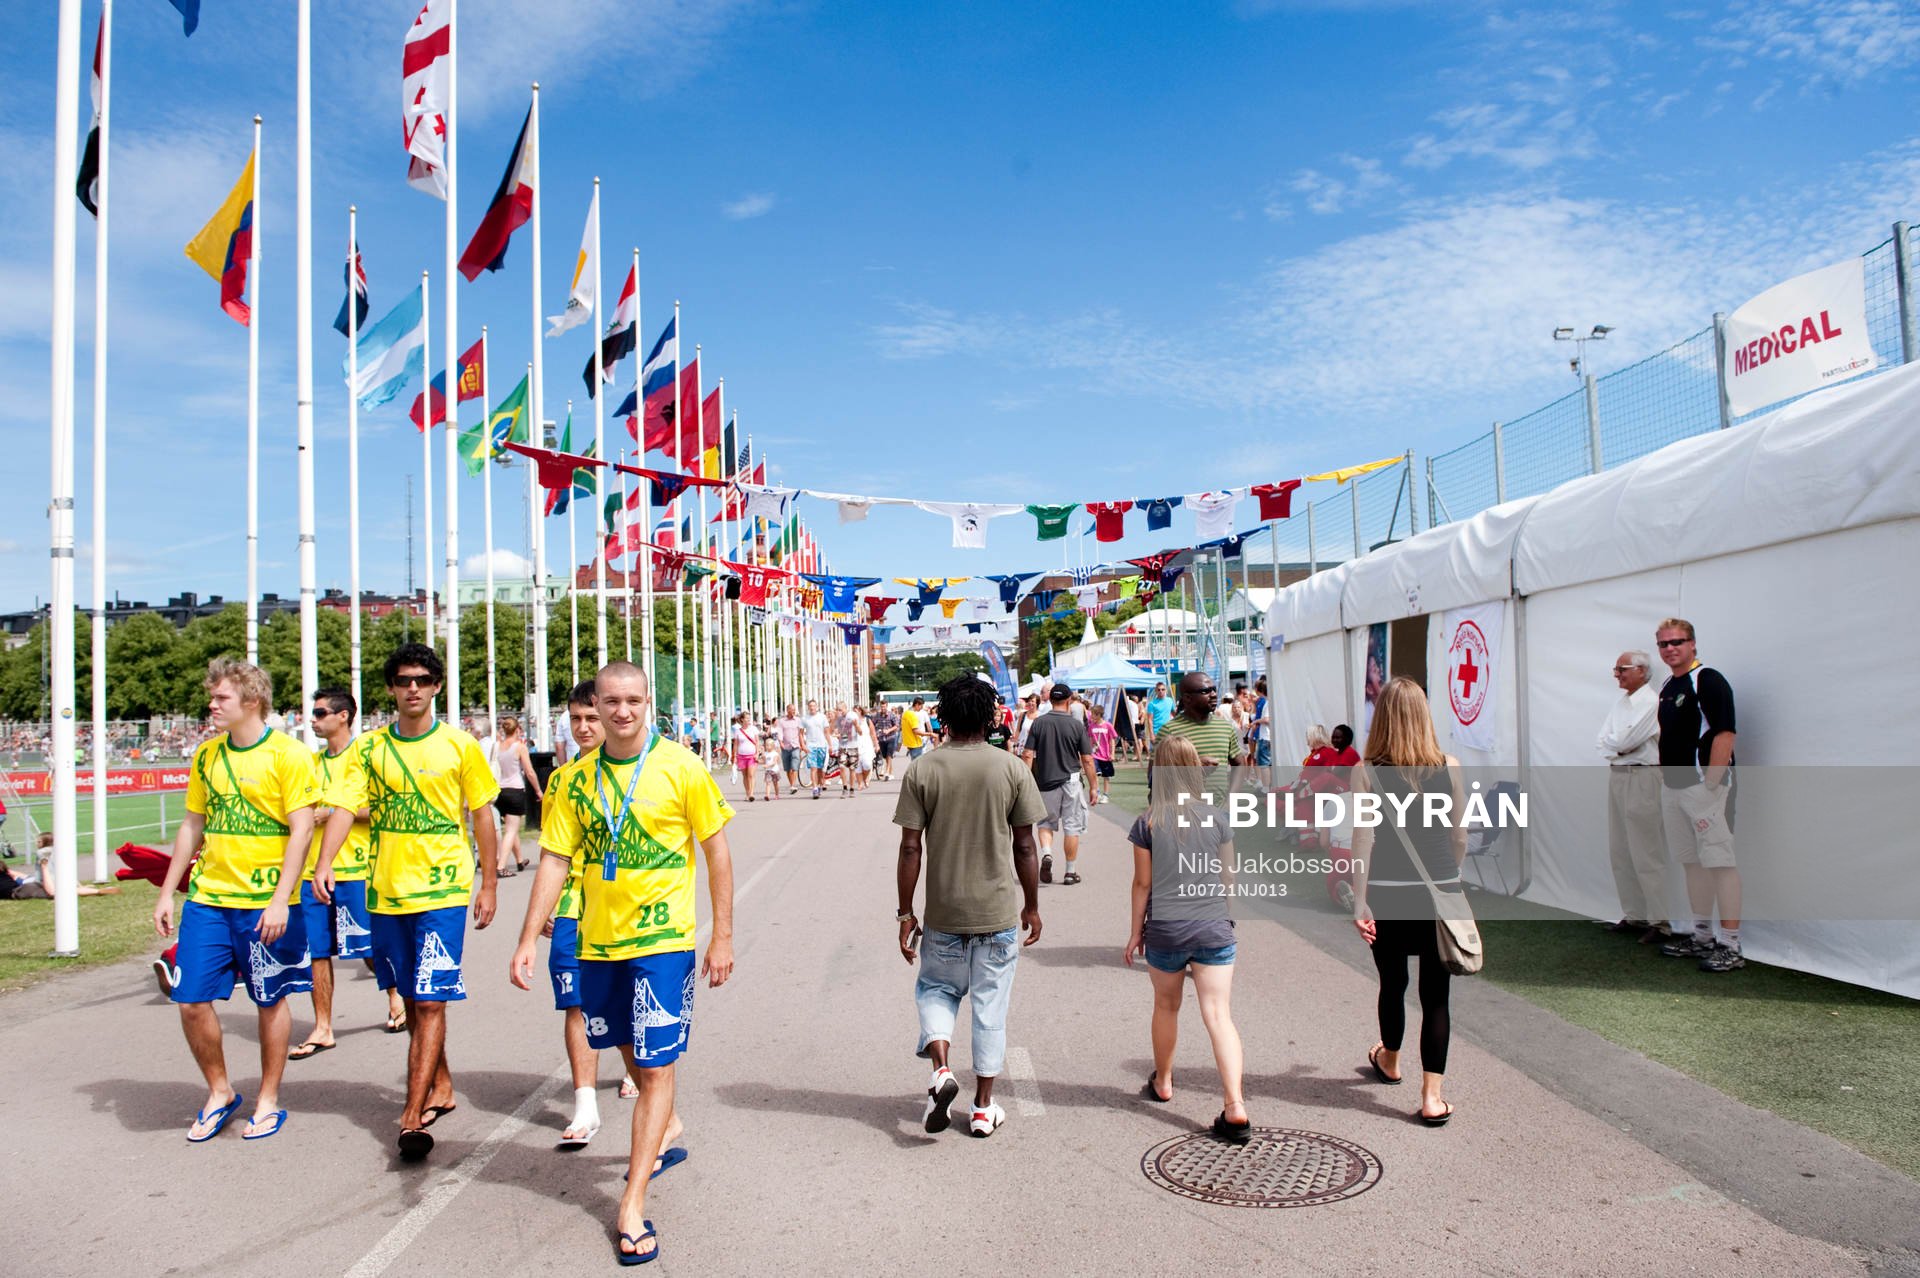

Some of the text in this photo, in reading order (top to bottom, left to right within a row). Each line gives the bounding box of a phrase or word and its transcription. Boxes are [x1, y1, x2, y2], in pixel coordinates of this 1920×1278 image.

[1735, 310, 1842, 376] MEDICAL
[747, 573, 763, 587] 10
[1138, 579, 1152, 591] 27
[250, 867, 281, 888] 40
[429, 864, 457, 885] 39
[636, 902, 670, 929] 28
[555, 972, 574, 995] 12
